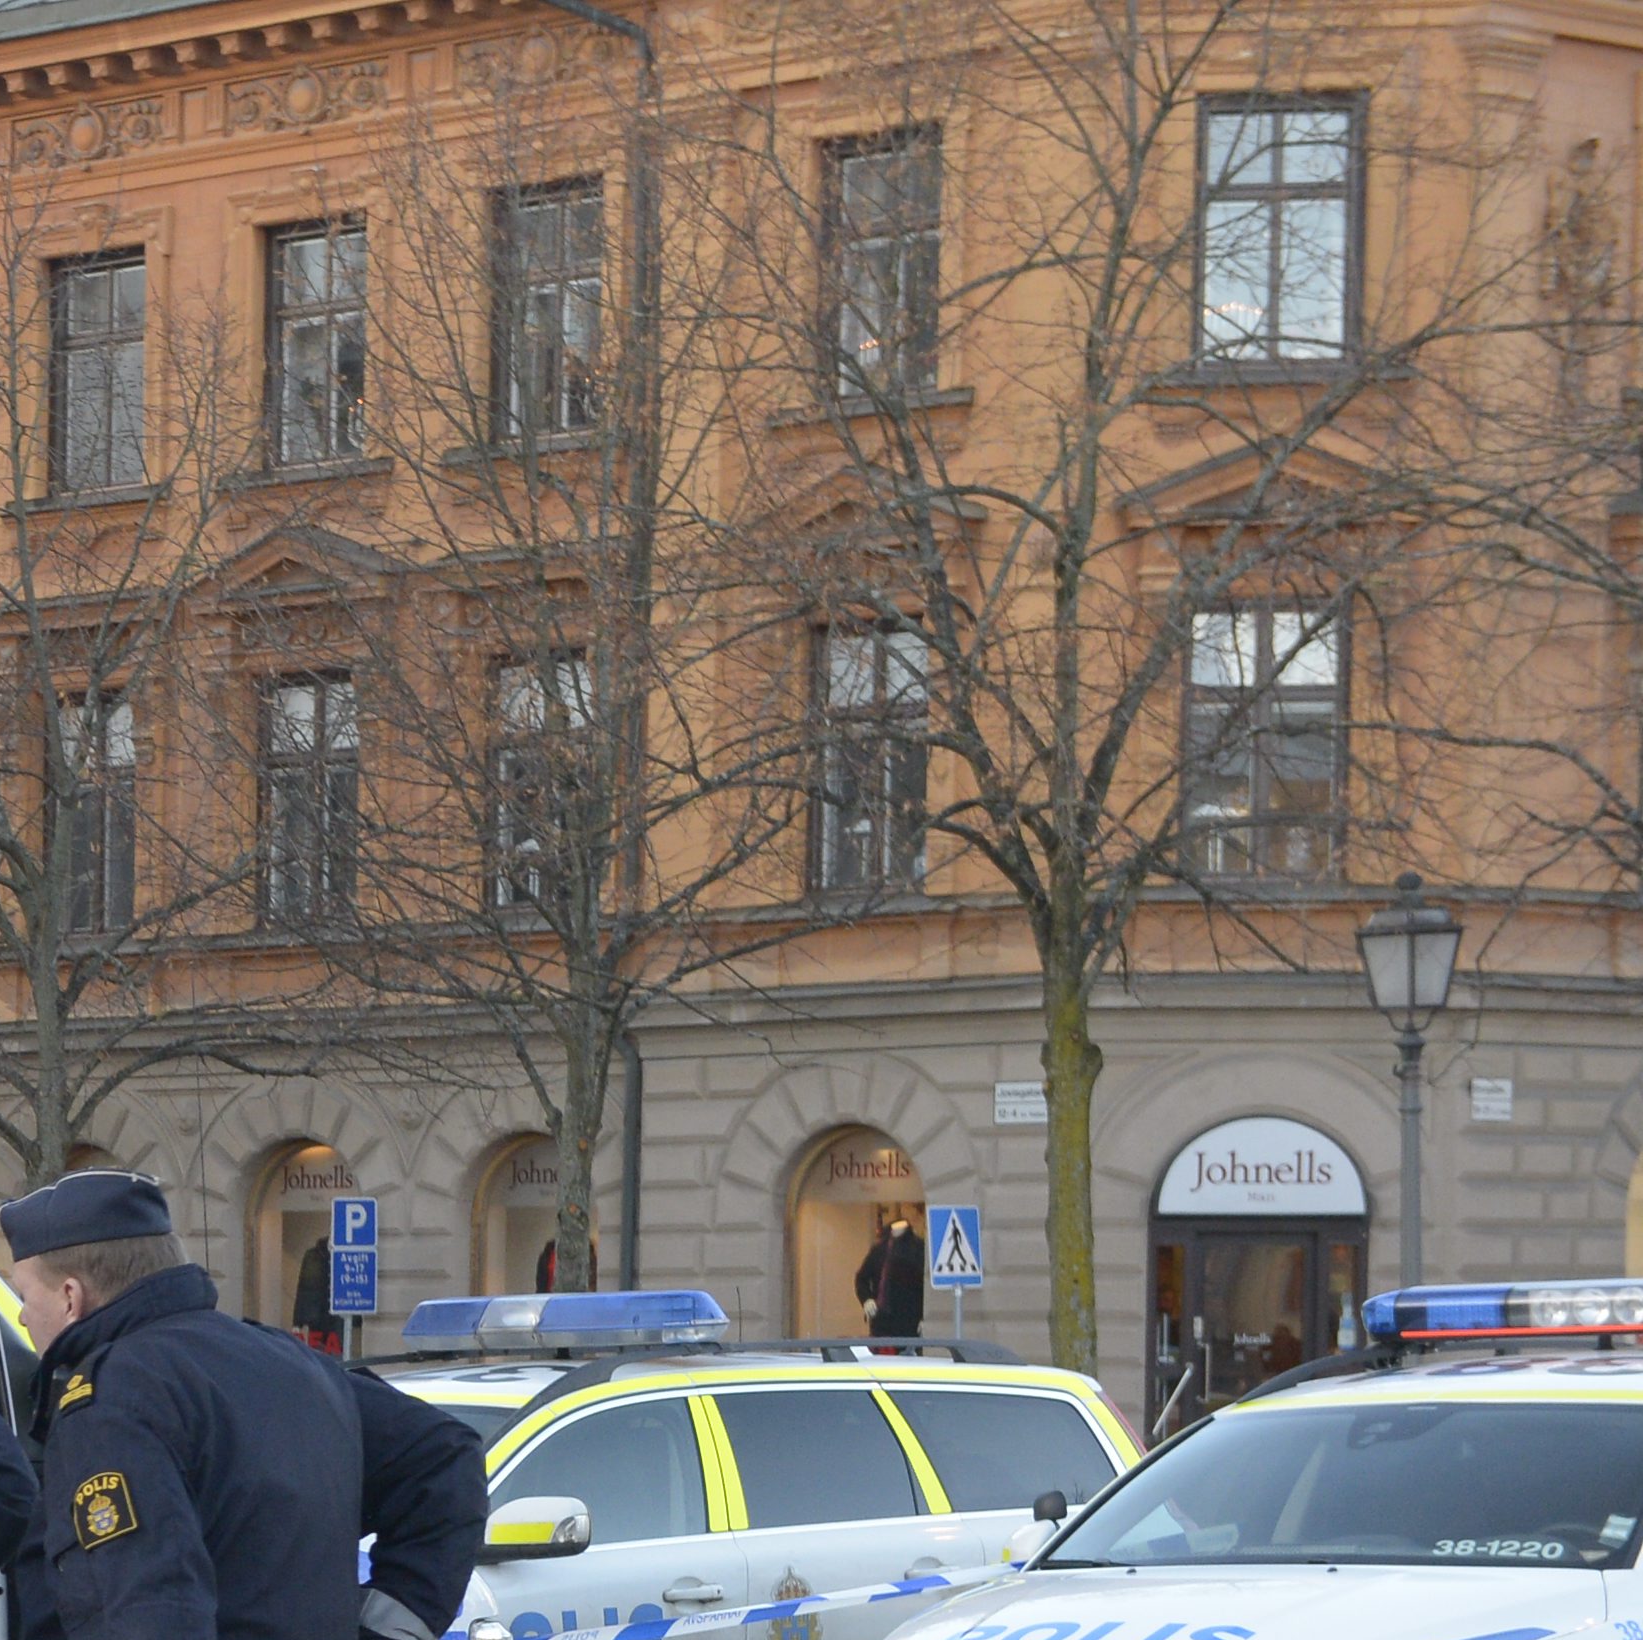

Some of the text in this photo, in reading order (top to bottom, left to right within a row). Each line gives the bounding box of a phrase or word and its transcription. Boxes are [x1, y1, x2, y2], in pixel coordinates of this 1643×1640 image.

[281, 1165, 353, 1194] Johnells
[825, 1152, 910, 1185] Johnells
[1190, 1150, 1332, 1192] Johnells
[346, 1203, 367, 1243] P
[76, 1476, 120, 1506] POLIS
[1432, 1539, 1565, 1560] 38-1220
